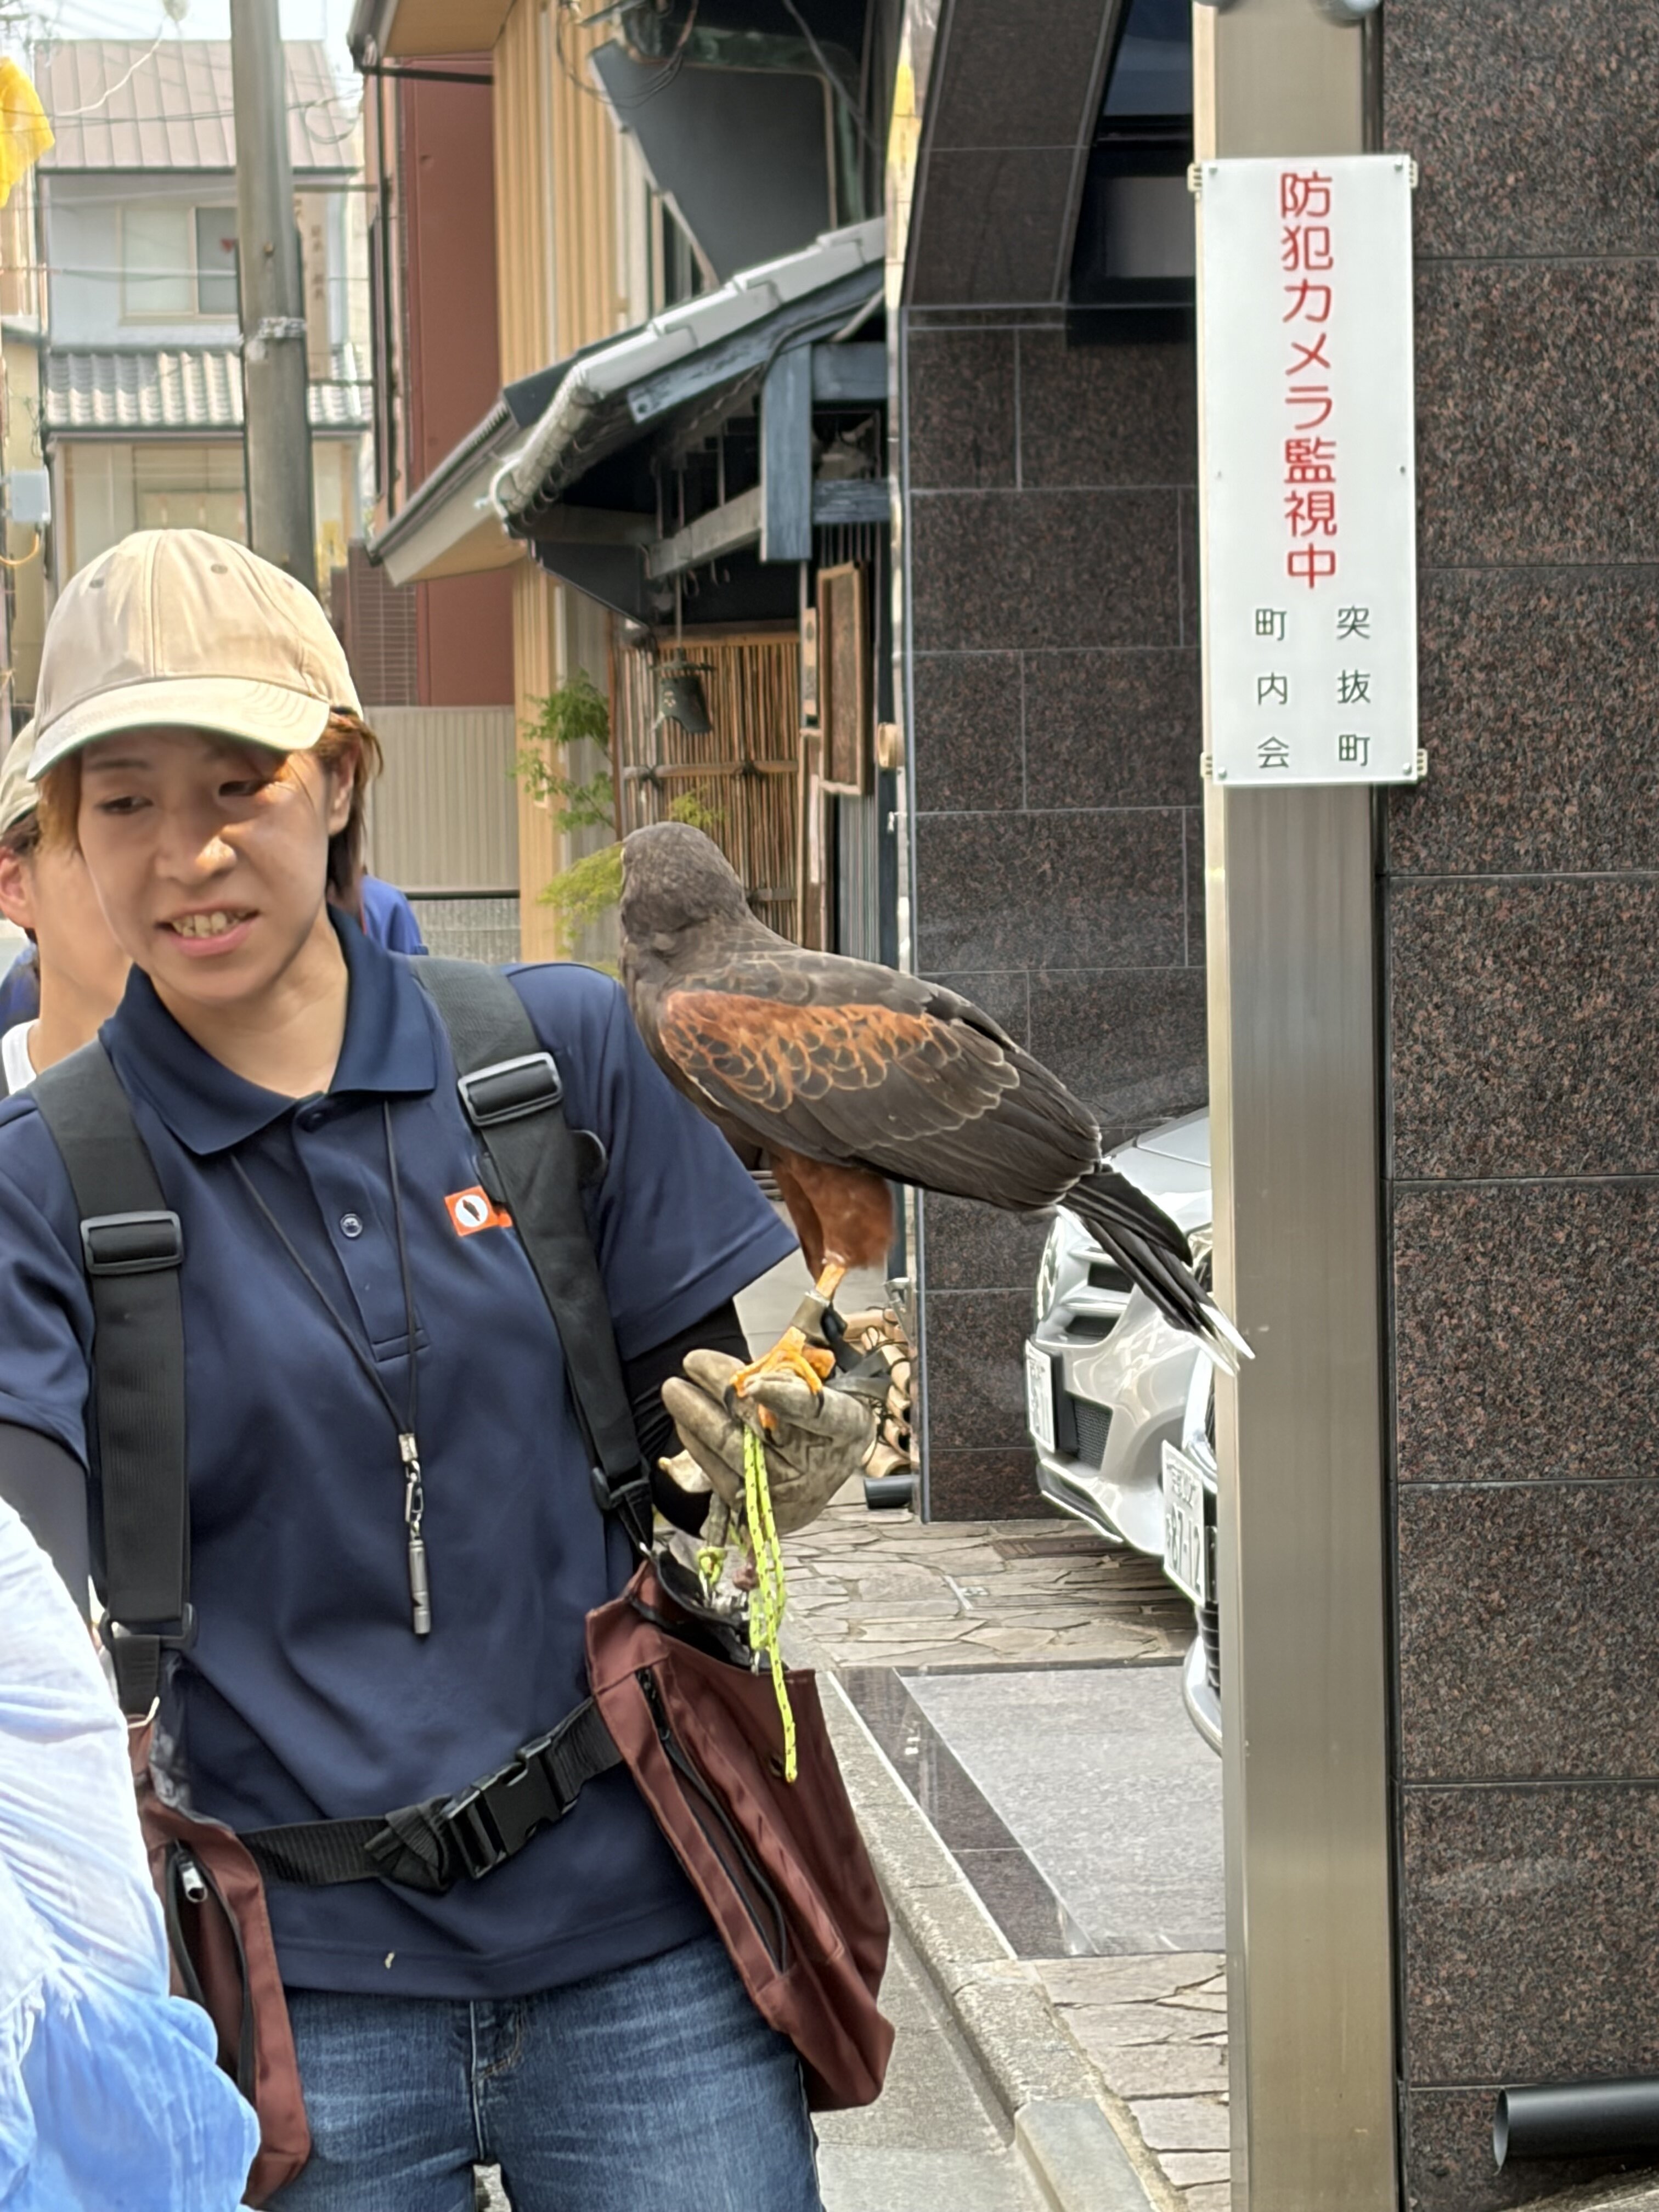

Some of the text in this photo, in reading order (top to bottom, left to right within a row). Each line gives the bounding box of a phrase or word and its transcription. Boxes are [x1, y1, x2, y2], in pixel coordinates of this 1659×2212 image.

[1280, 171, 1338, 589] 防犯カメラ監視中
[1255, 608, 1289, 769] 町内会
[1336, 605, 1370, 767] 突抜町
